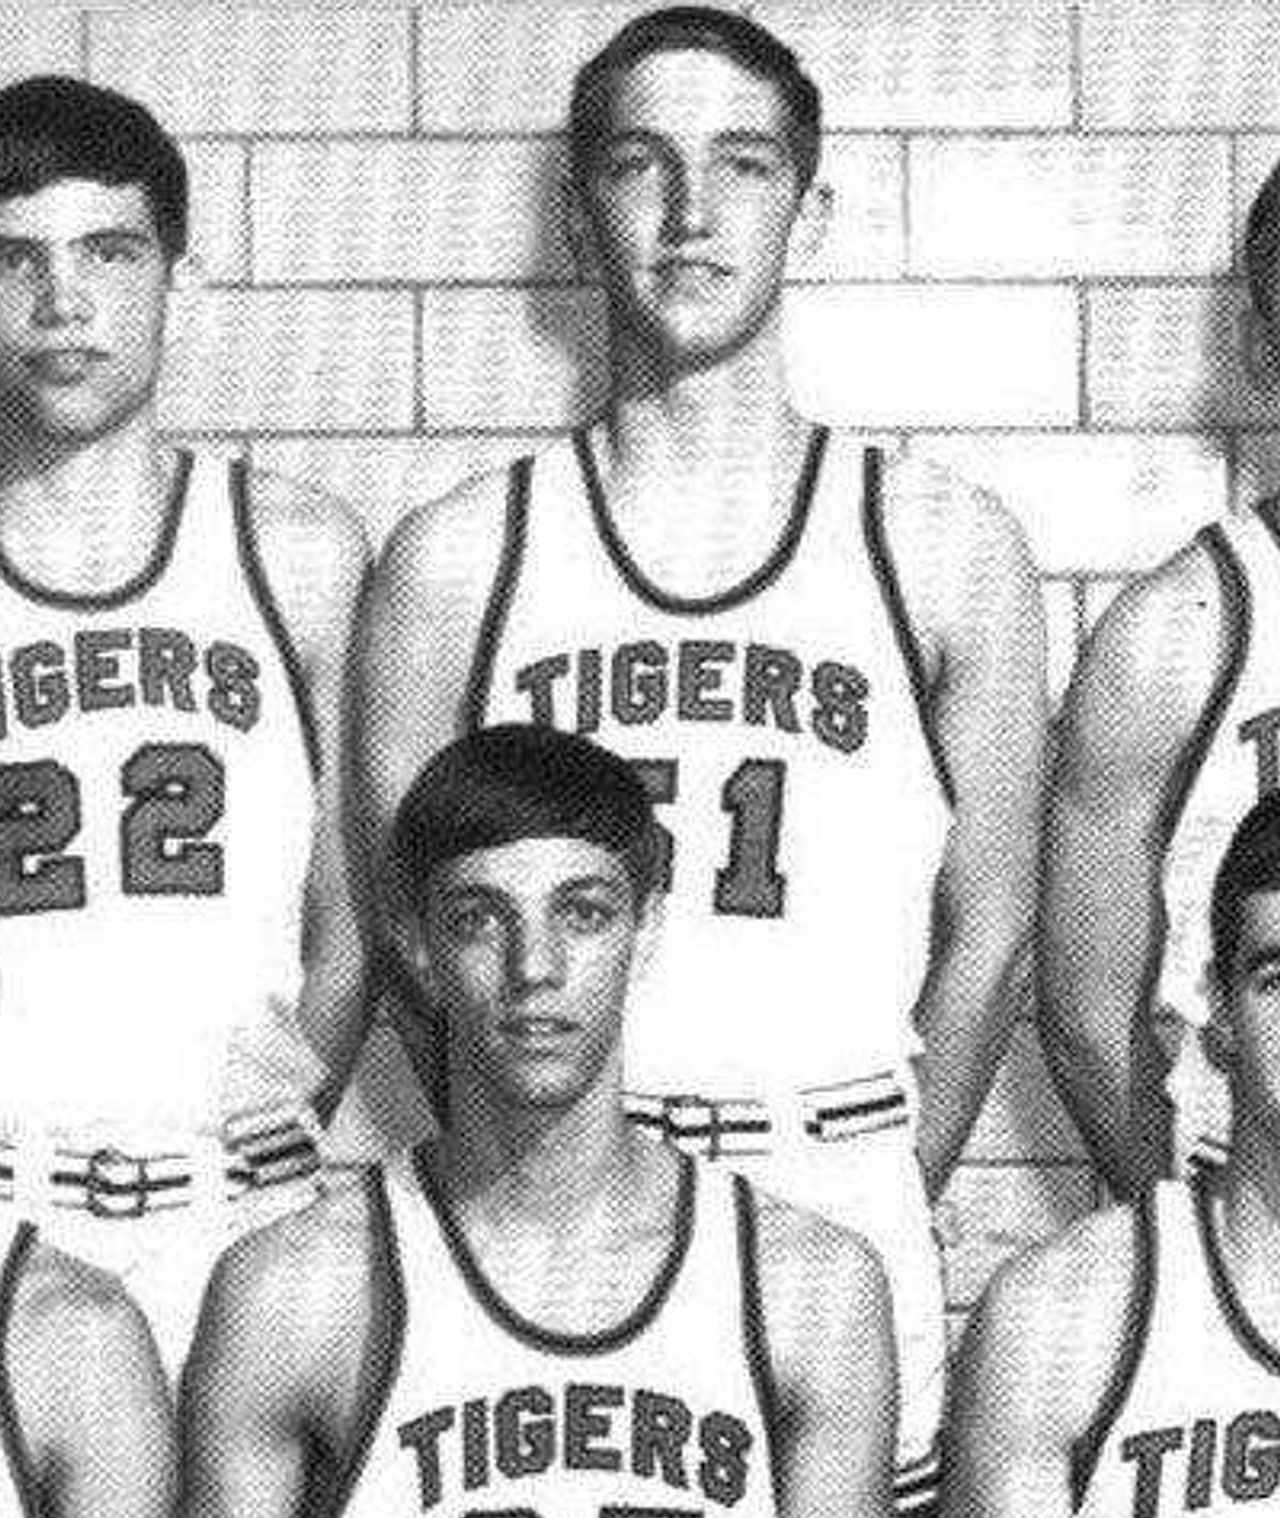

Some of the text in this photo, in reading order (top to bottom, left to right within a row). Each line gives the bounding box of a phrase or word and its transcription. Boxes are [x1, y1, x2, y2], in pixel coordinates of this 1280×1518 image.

[517, 640, 869, 755] TIGERS
[625, 757, 787, 918] 1
[399, 1384, 753, 1512] TIGERS
